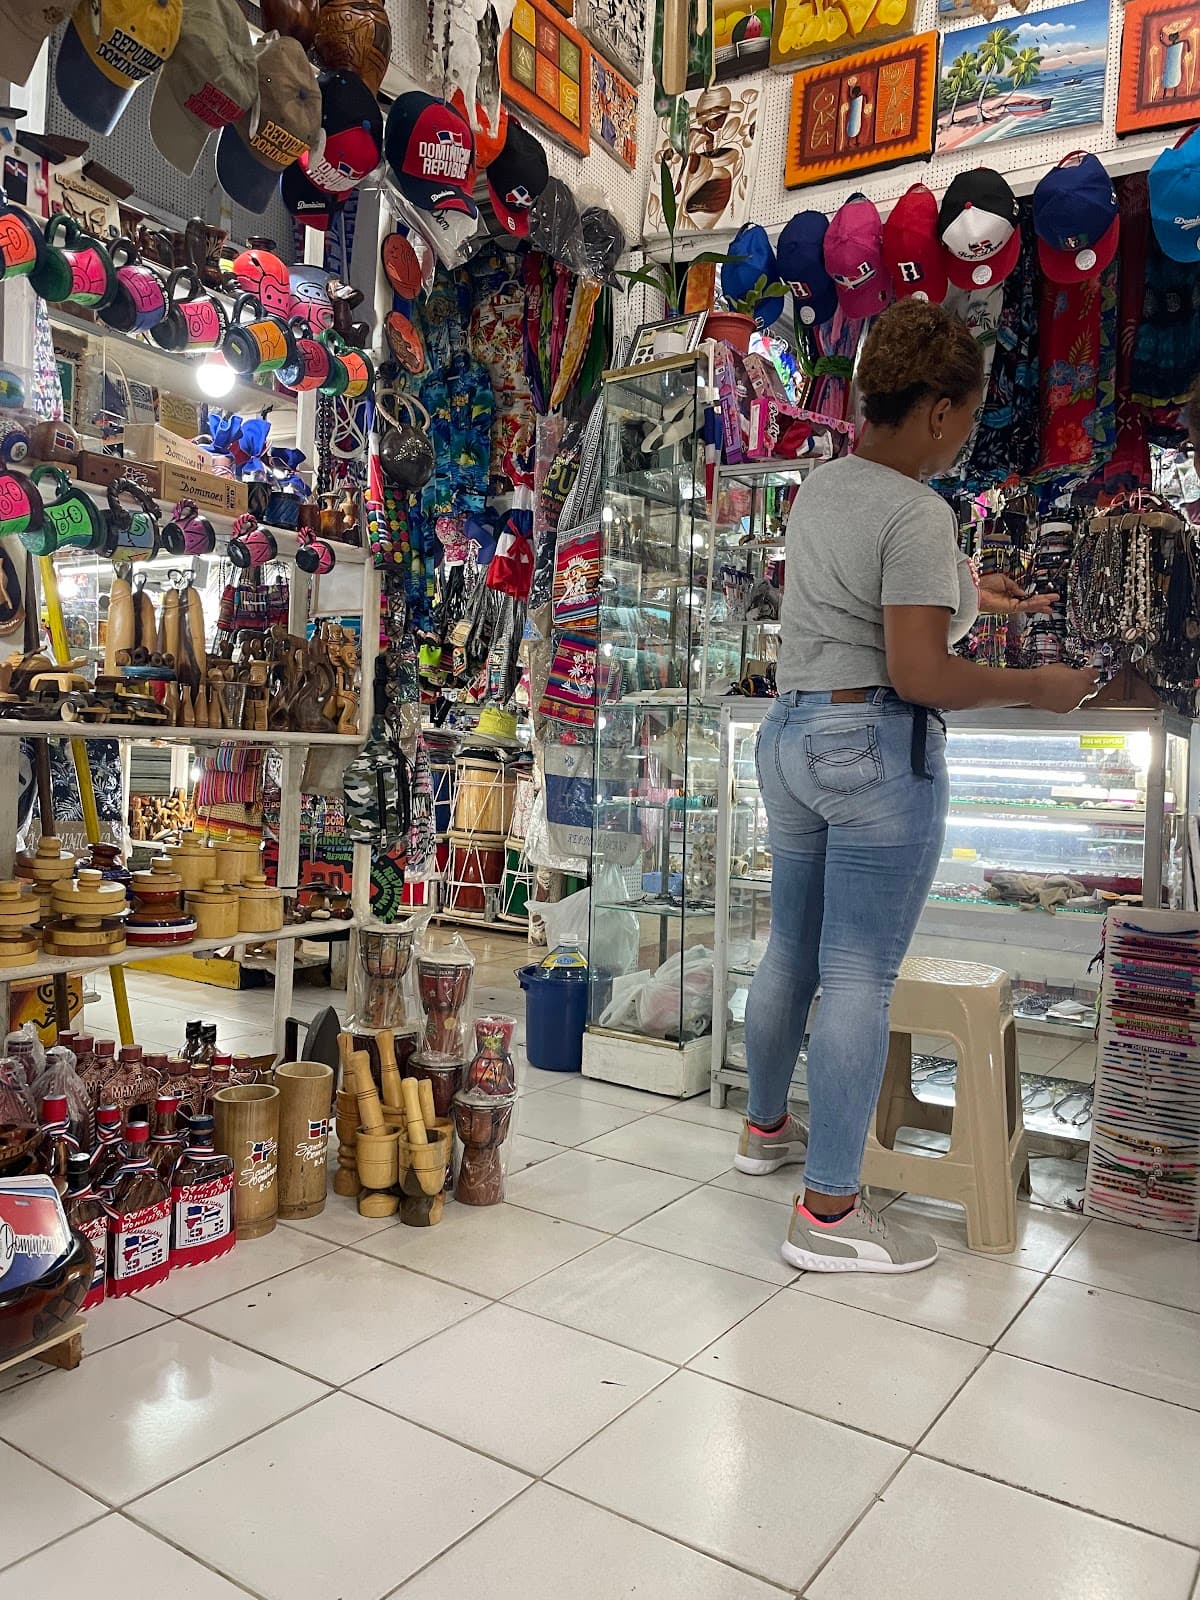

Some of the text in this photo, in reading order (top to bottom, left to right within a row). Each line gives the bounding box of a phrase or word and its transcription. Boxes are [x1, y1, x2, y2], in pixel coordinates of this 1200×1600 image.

[109, 28, 164, 72] REPUBLI
[179, 481, 223, 502] Dominoes
[0, 1223, 62, 1260] Dominican
